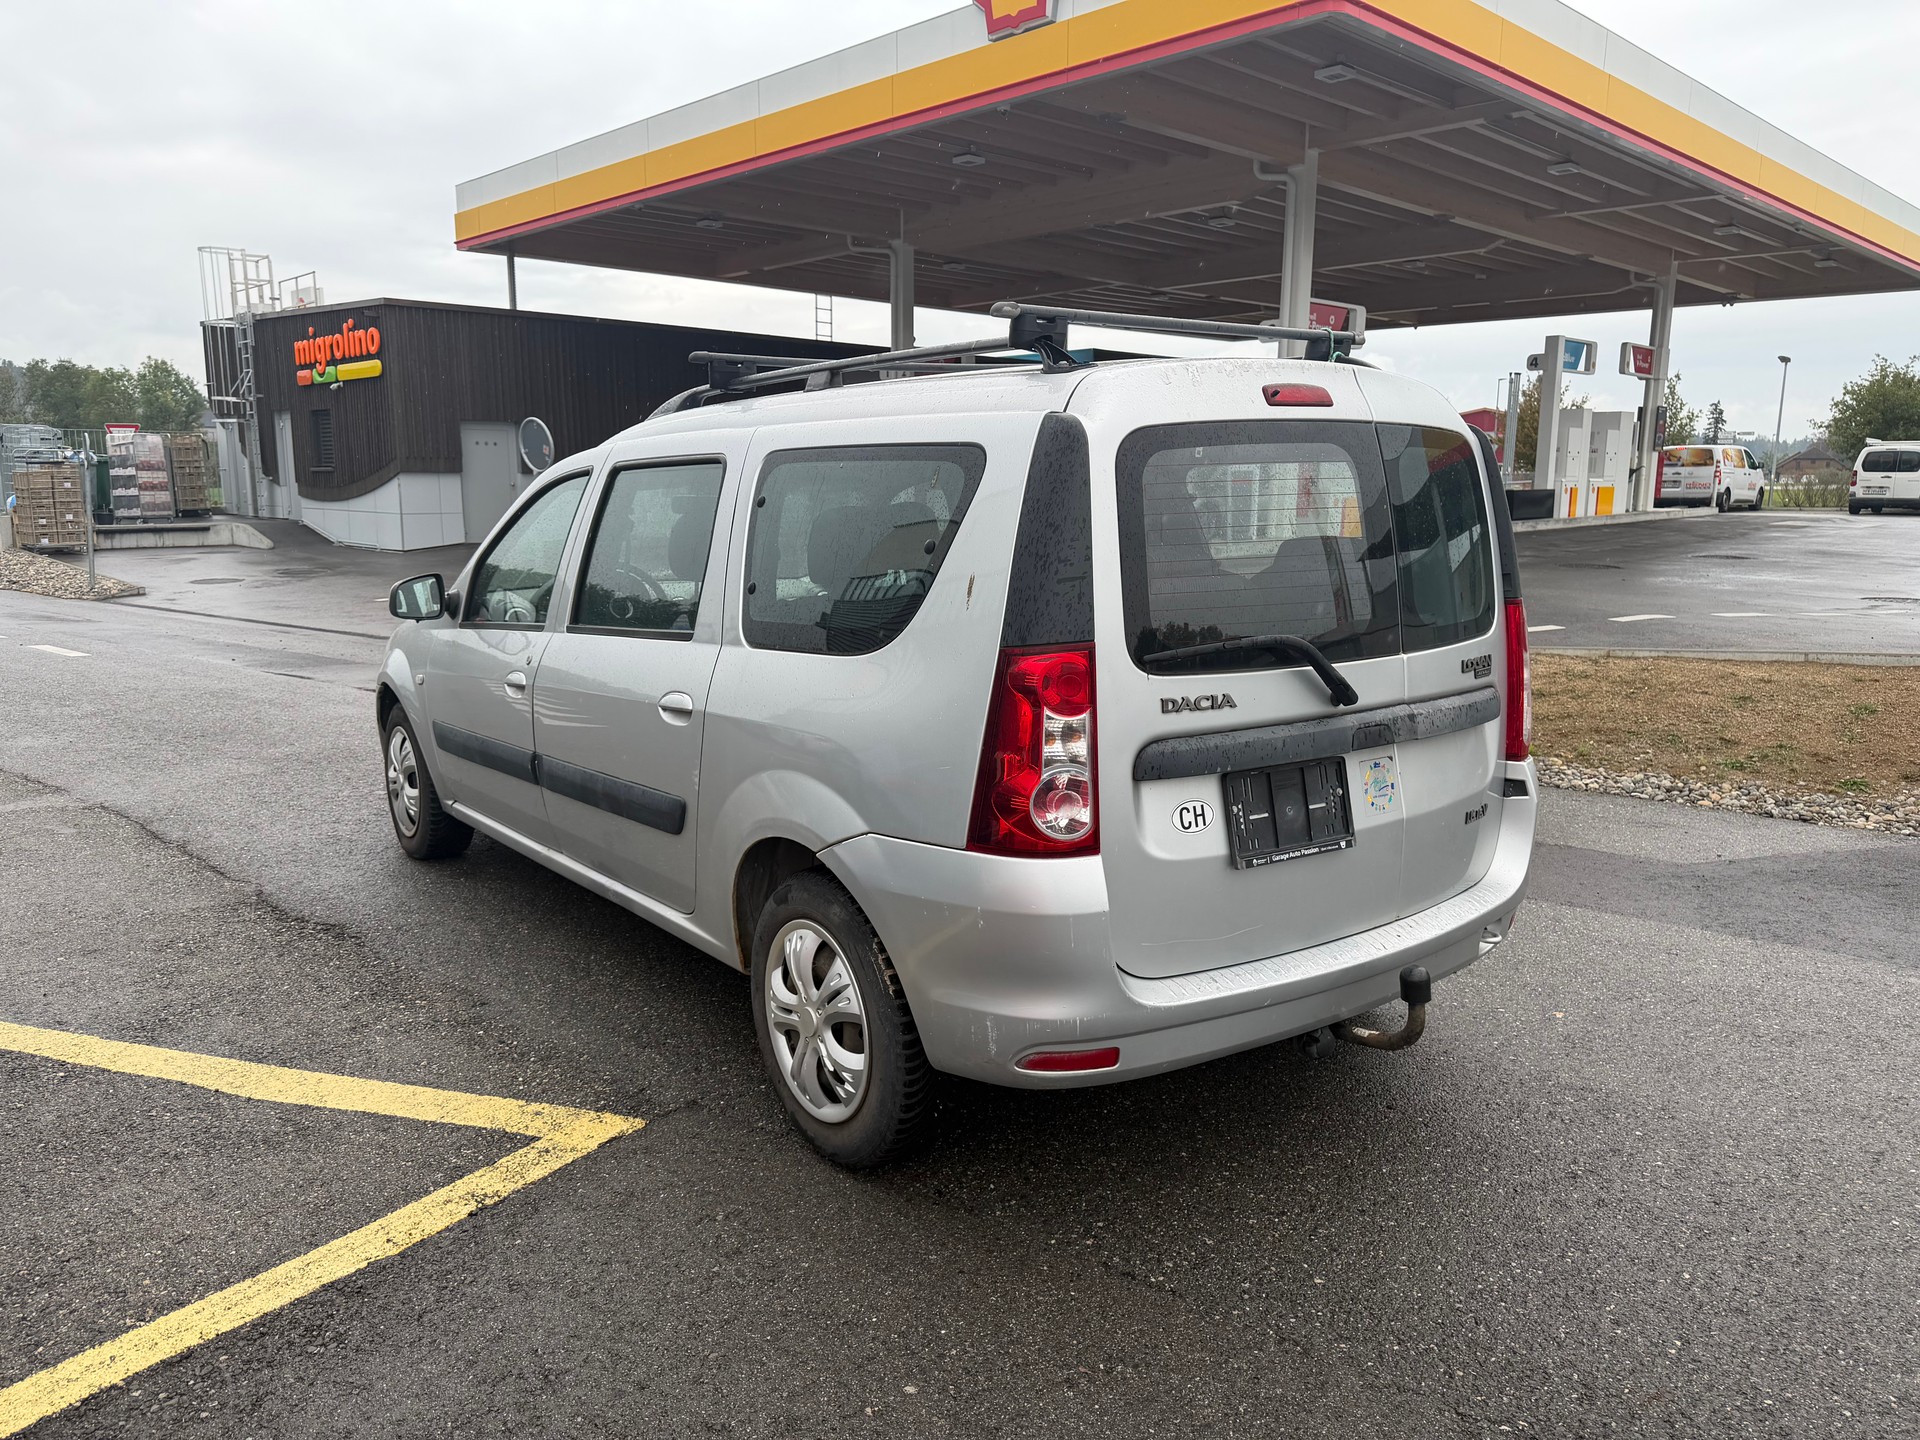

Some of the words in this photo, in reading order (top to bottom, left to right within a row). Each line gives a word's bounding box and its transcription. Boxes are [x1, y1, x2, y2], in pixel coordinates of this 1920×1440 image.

[294, 318, 381, 374] migrolino
[1529, 356, 1539, 368] 4
[1160, 693, 1238, 714] DACIA
[1179, 804, 1206, 830] CH
[1271, 852, 1289, 862] Garage
[1289, 850, 1301, 859] Auto
[1301, 846, 1320, 856] Passion
